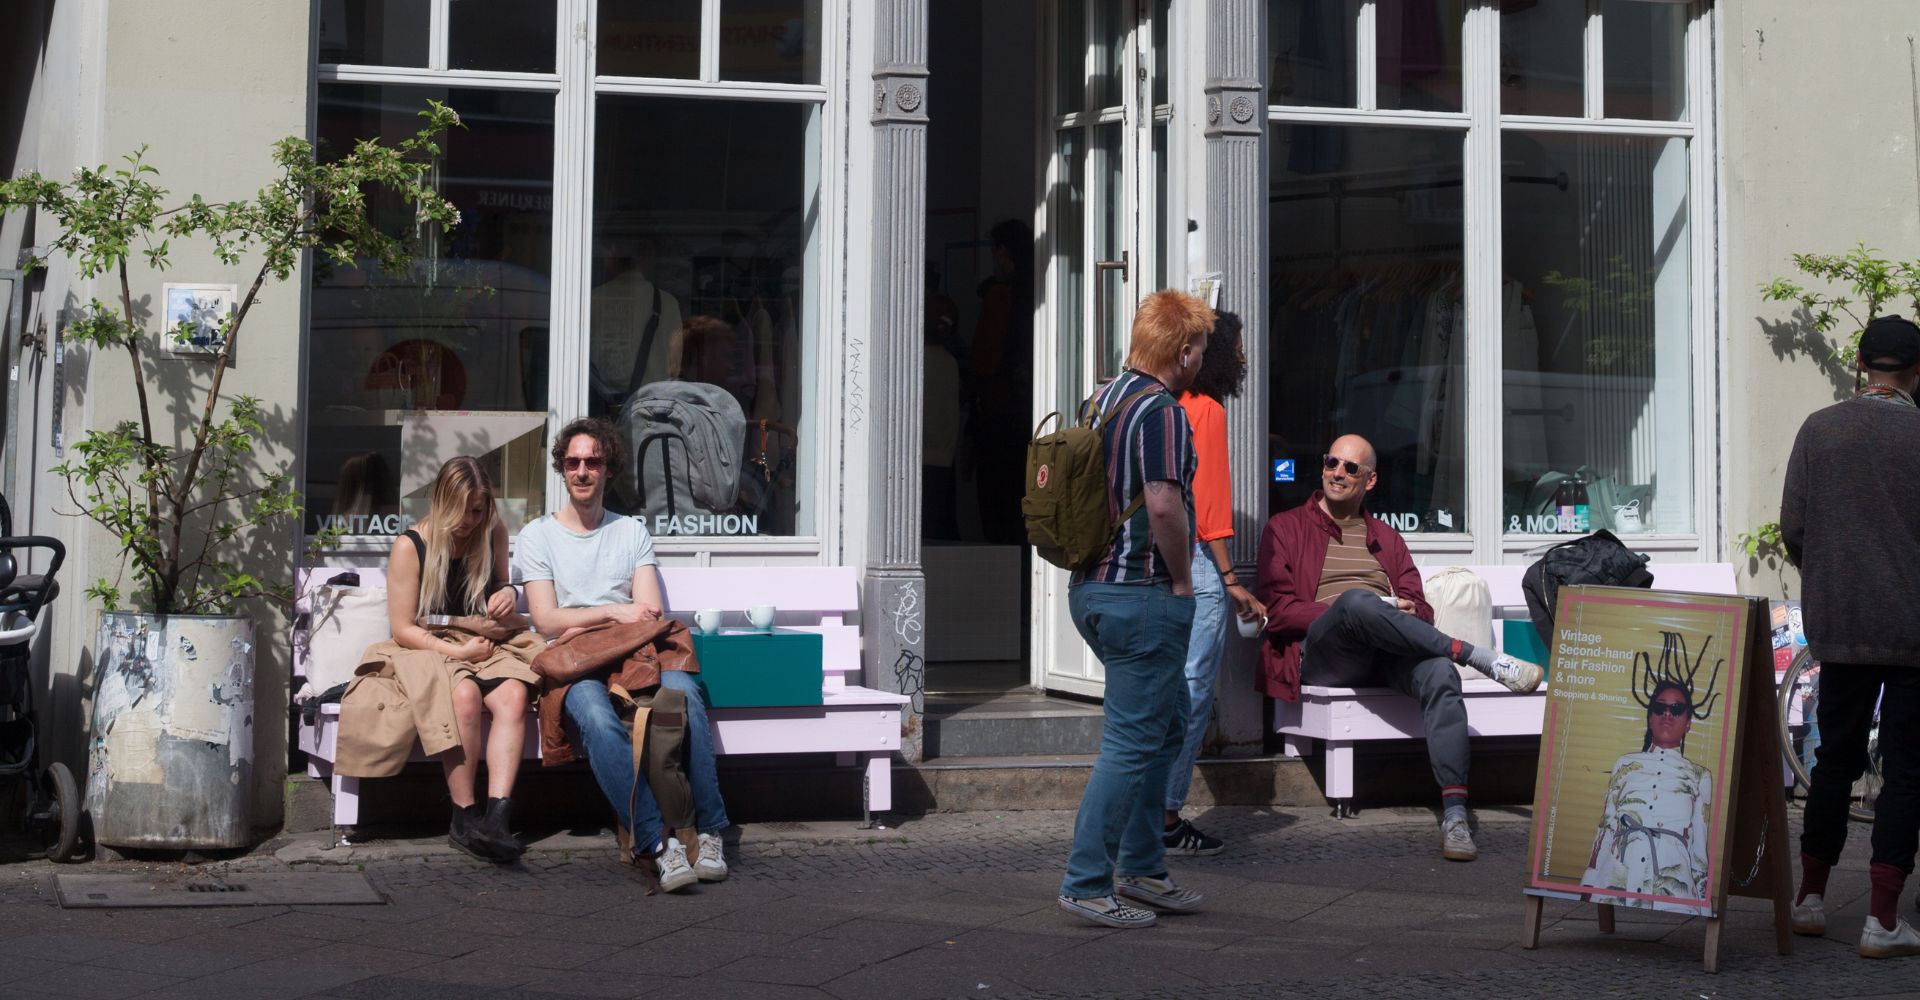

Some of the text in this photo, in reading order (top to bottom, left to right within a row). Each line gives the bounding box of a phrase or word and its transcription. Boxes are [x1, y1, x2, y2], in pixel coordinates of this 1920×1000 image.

[655, 514, 758, 534] FASHION
[1373, 513, 1419, 532] AND
[1509, 515, 1583, 533] & MORE
[1560, 629, 1602, 644] Vintage
[1558, 643, 1634, 660] Second-hand
[1557, 657, 1625, 673] Fair Fashion
[1555, 671, 1596, 685] & more
[1553, 688, 1589, 701] Shopping
[1598, 693, 1628, 704] Sharing
